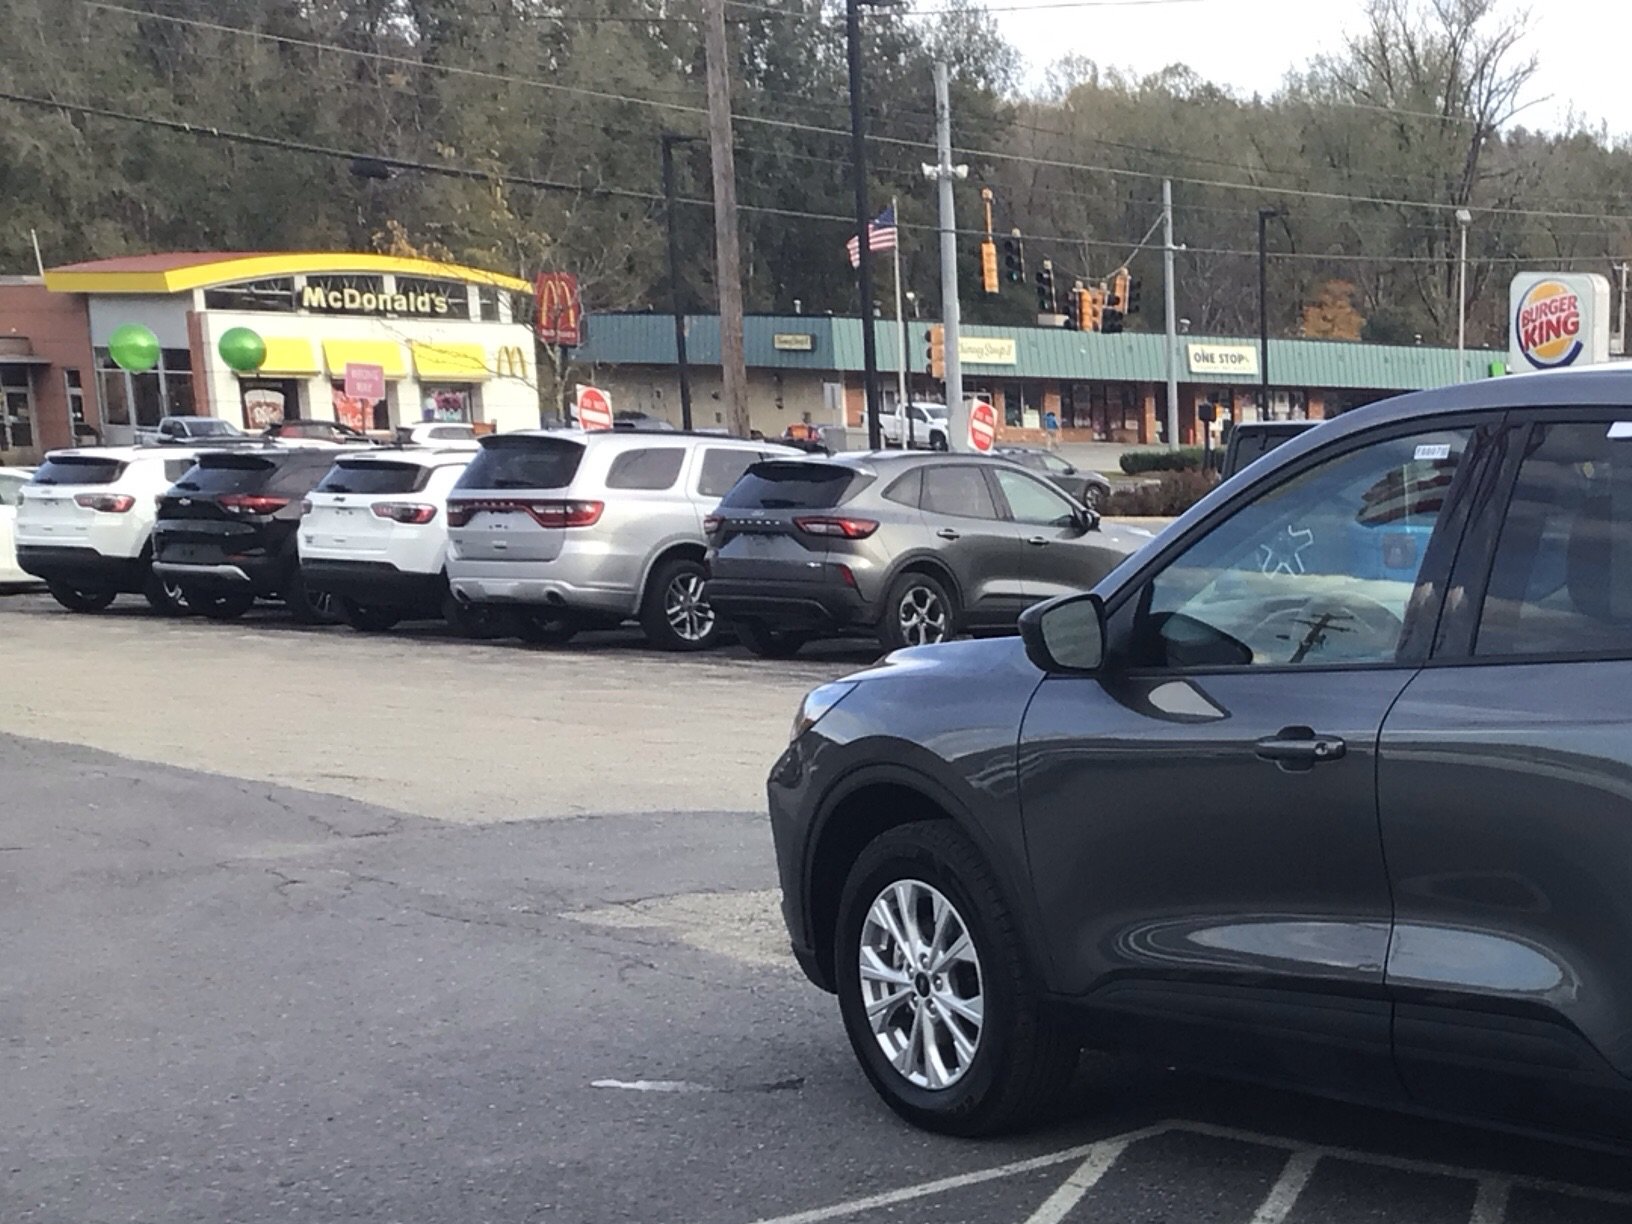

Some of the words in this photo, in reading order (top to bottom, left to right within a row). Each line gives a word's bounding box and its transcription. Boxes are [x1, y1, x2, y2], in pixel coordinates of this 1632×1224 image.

[302, 286, 448, 313] McDonald's
[1522, 295, 1578, 328] BURGER
[1523, 311, 1580, 351] KING
[1194, 351, 1216, 364] ONE
[1218, 353, 1245, 364] STOP
